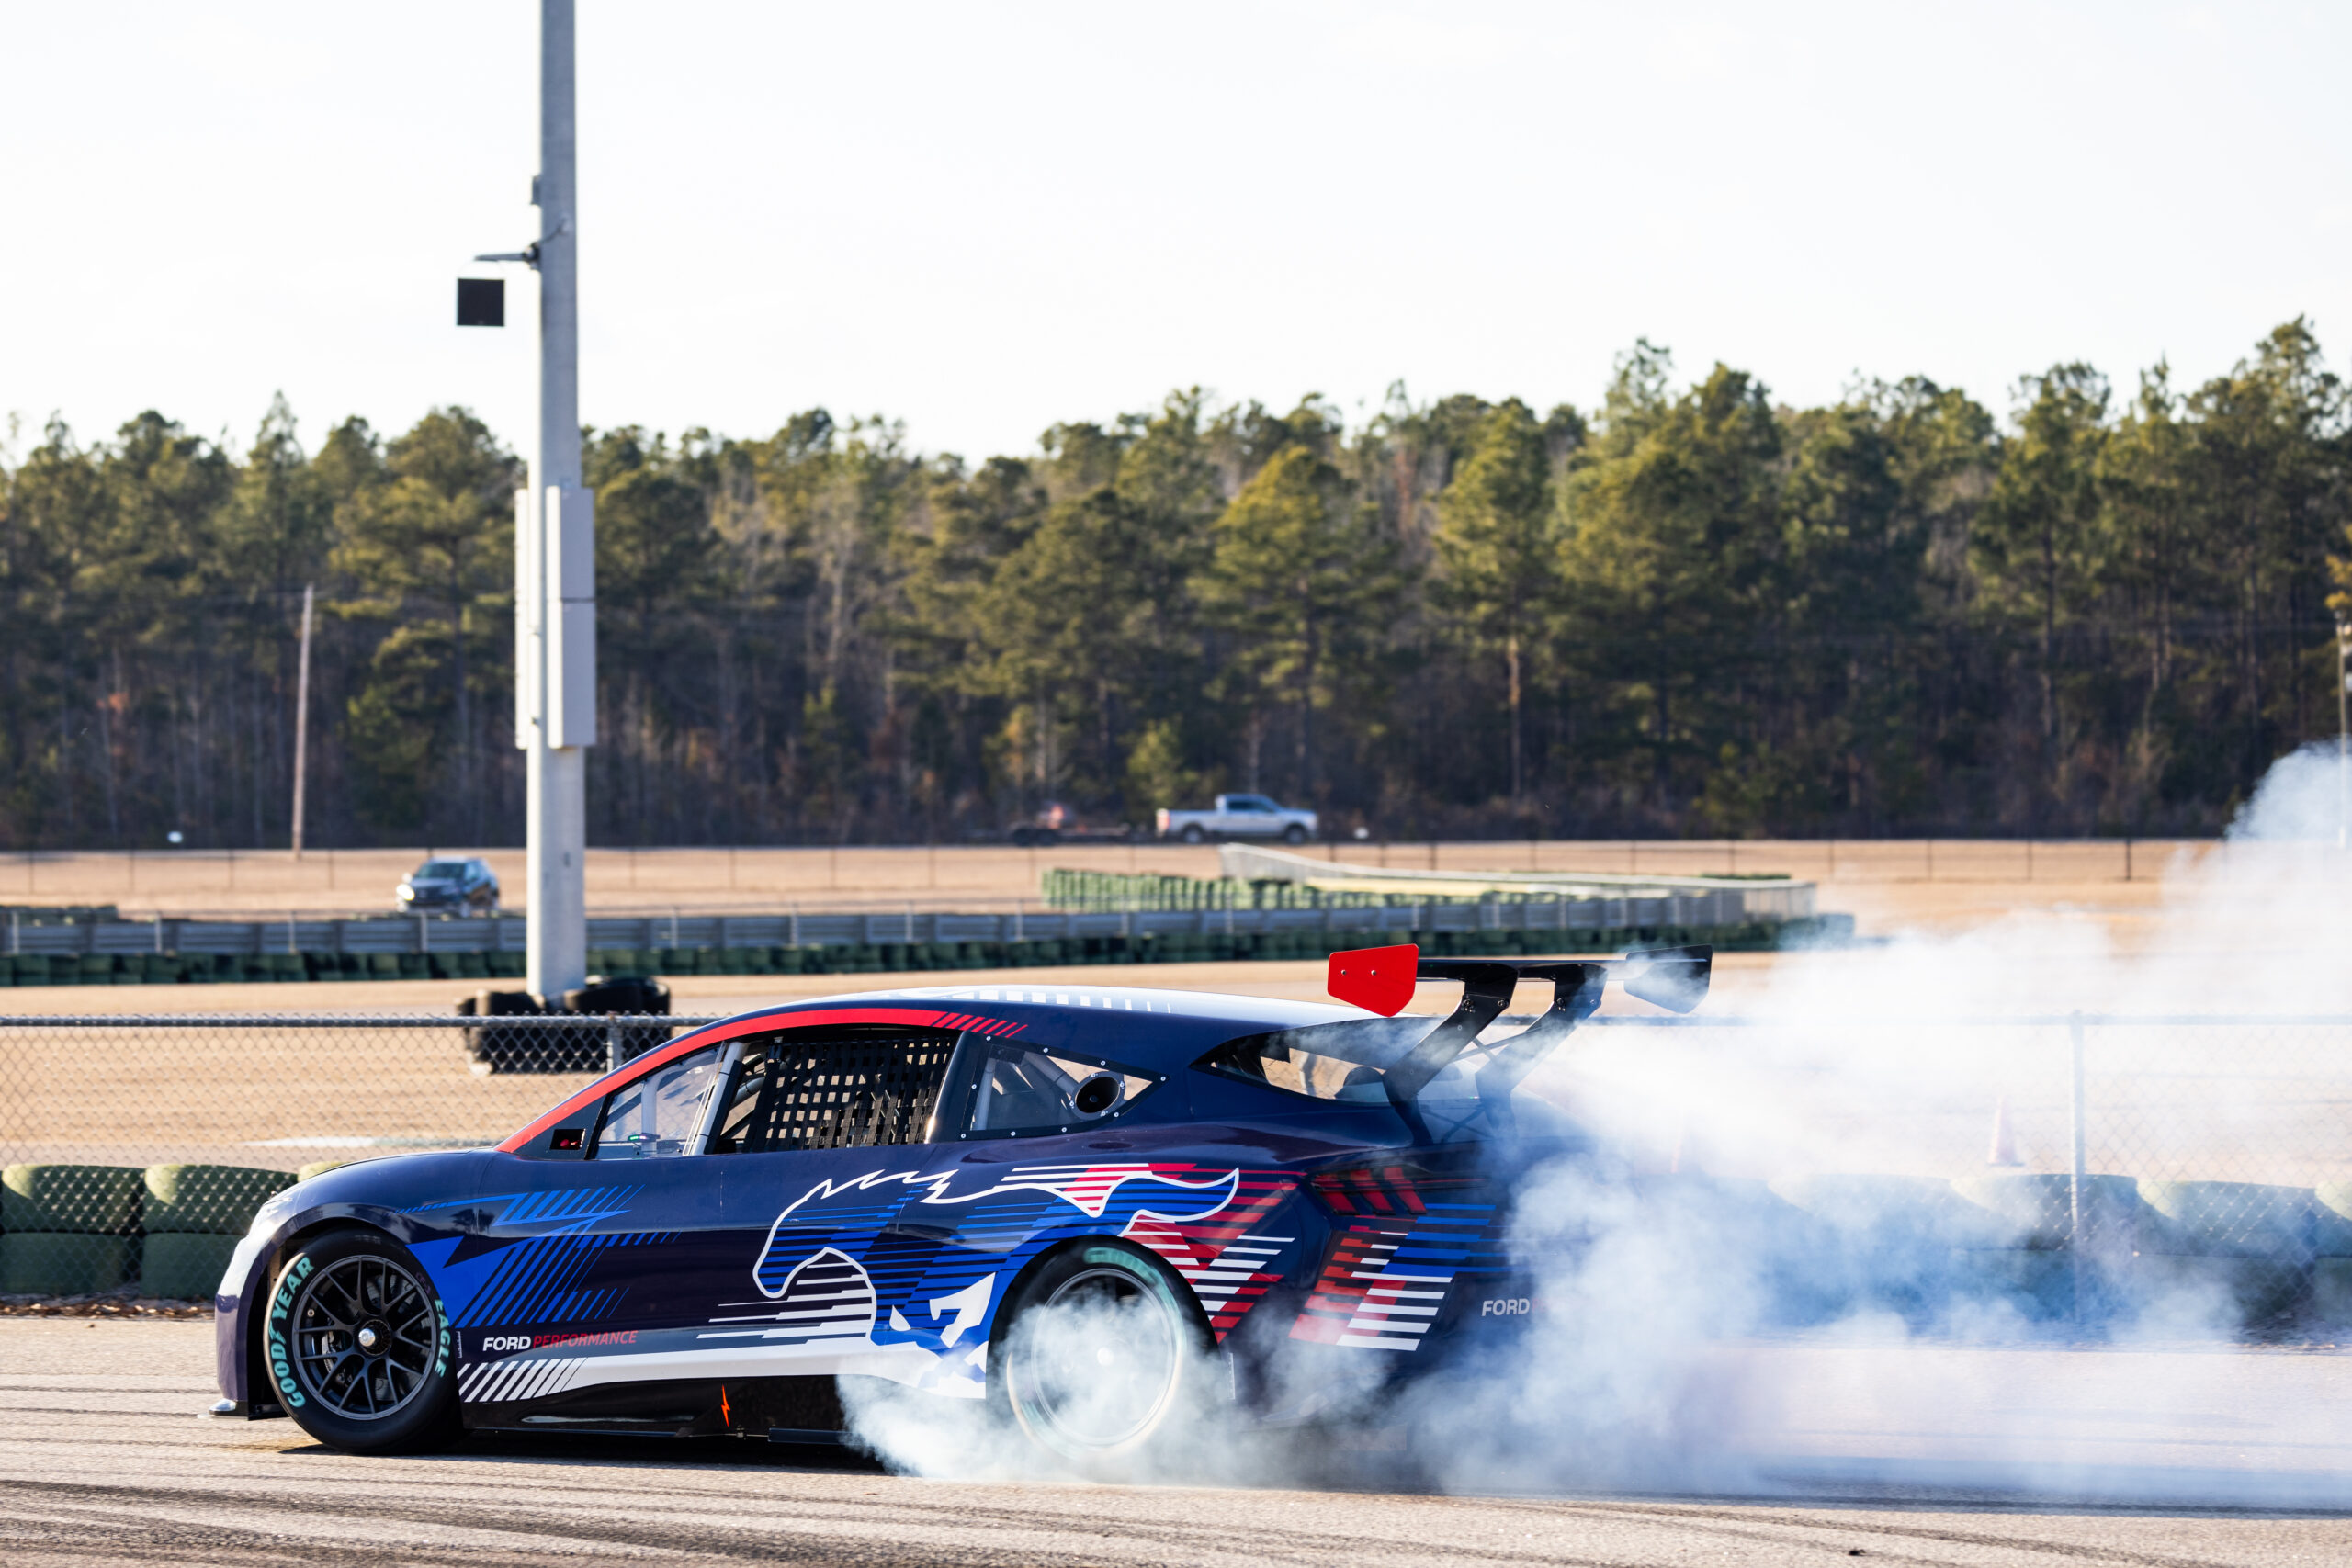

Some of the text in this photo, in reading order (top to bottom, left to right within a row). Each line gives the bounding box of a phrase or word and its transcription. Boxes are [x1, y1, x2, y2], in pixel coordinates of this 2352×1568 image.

[1481, 1298, 1530, 1316] FORD
[435, 1299, 451, 1378] EAGLE
[482, 1330, 639, 1351] FORD PERFORMANCE
